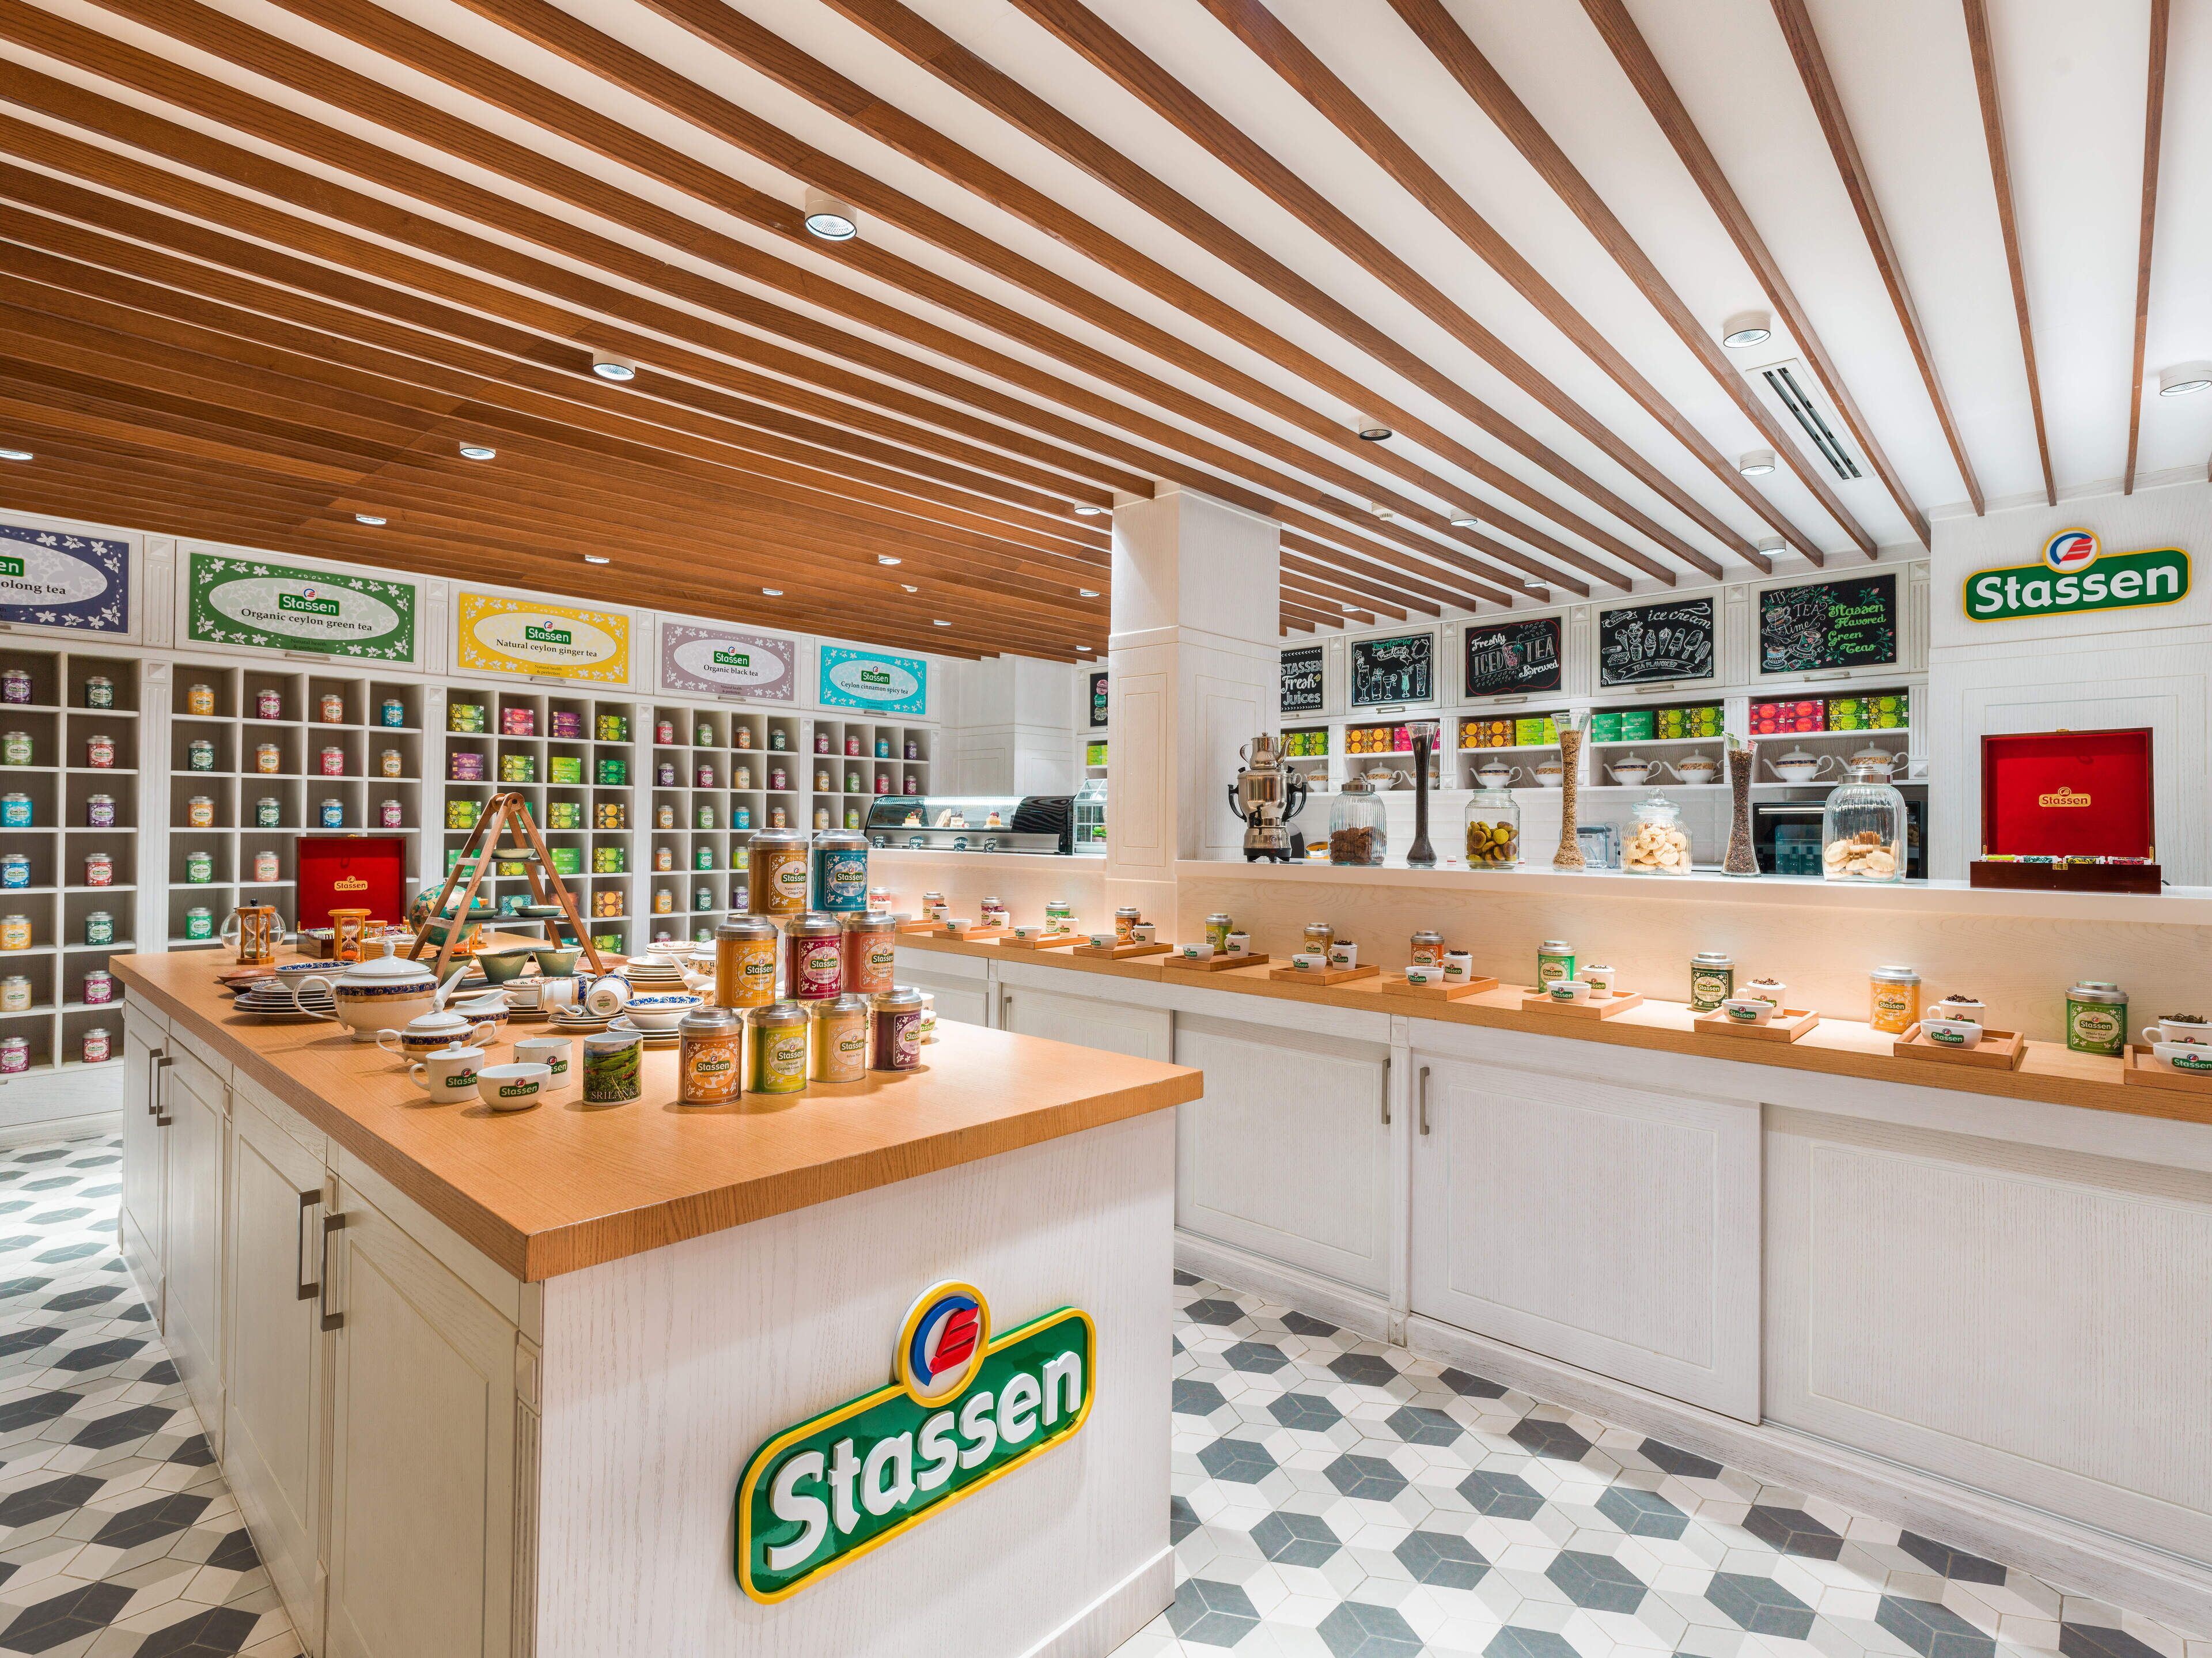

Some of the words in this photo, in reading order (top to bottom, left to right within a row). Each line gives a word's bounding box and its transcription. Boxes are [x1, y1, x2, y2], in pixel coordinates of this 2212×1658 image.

[0, 580, 42, 595] olong
[47, 584, 66, 595] tea
[1975, 566, 2178, 613] Stassen
[283, 596, 336, 614] Stassen
[1794, 603, 1823, 618] TEA
[1828, 604, 1885, 618] Stassen
[241, 608, 286, 621] Organic
[289, 615, 323, 626] ceylon
[326, 620, 355, 629] green
[358, 623, 372, 631] tea
[1648, 610, 1668, 622] ice
[1669, 609, 1711, 629] cream
[1835, 615, 1887, 629] Flavored
[528, 629, 569, 642] Stassen
[1828, 631, 1863, 646] Green
[1472, 633, 1507, 651] Freshly
[496, 639, 528, 649] Natural
[530, 643, 556, 653] ceylon
[559, 648, 585, 658] ginger
[715, 653, 748, 665] Stassen
[1475, 651, 1503, 676] ICED
[1525, 637, 1555, 663] TEA
[703, 664, 729, 673] Organic
[730, 667, 748, 676] black
[1519, 660, 1559, 678] Brewed
[863, 672, 888, 683] Stassen
[1281, 672, 1317, 694] Fresh
[841, 681, 860, 690] Ceylon
[861, 683, 886, 691] cinnamon
[887, 686, 900, 694] spicy
[1283, 691, 1321, 706] Juices
[2041, 796, 2088, 805] Stassen
[783, 875, 806, 883] Stassen
[747, 966, 773, 974] Stassen
[811, 960, 837, 968] Stassen
[1879, 1001, 1904, 1010] Stassen
[1730, 1010, 1755, 1019] Stassen
[2080, 1020, 2111, 1030] Stassen
[1932, 1032, 1963, 1043] Stassen
[840, 1042, 864, 1051] Stassen
[778, 1051, 804, 1060] Stassen
[551, 1063, 567, 1073] ssen
[698, 1062, 730, 1072] Stassen
[2174, 1058, 2212, 1069] Stassen
[447, 1077, 477, 1086] Stasse
[501, 1085, 537, 1096] Stassen
[767, 1350, 1082, 1571] Stassen
